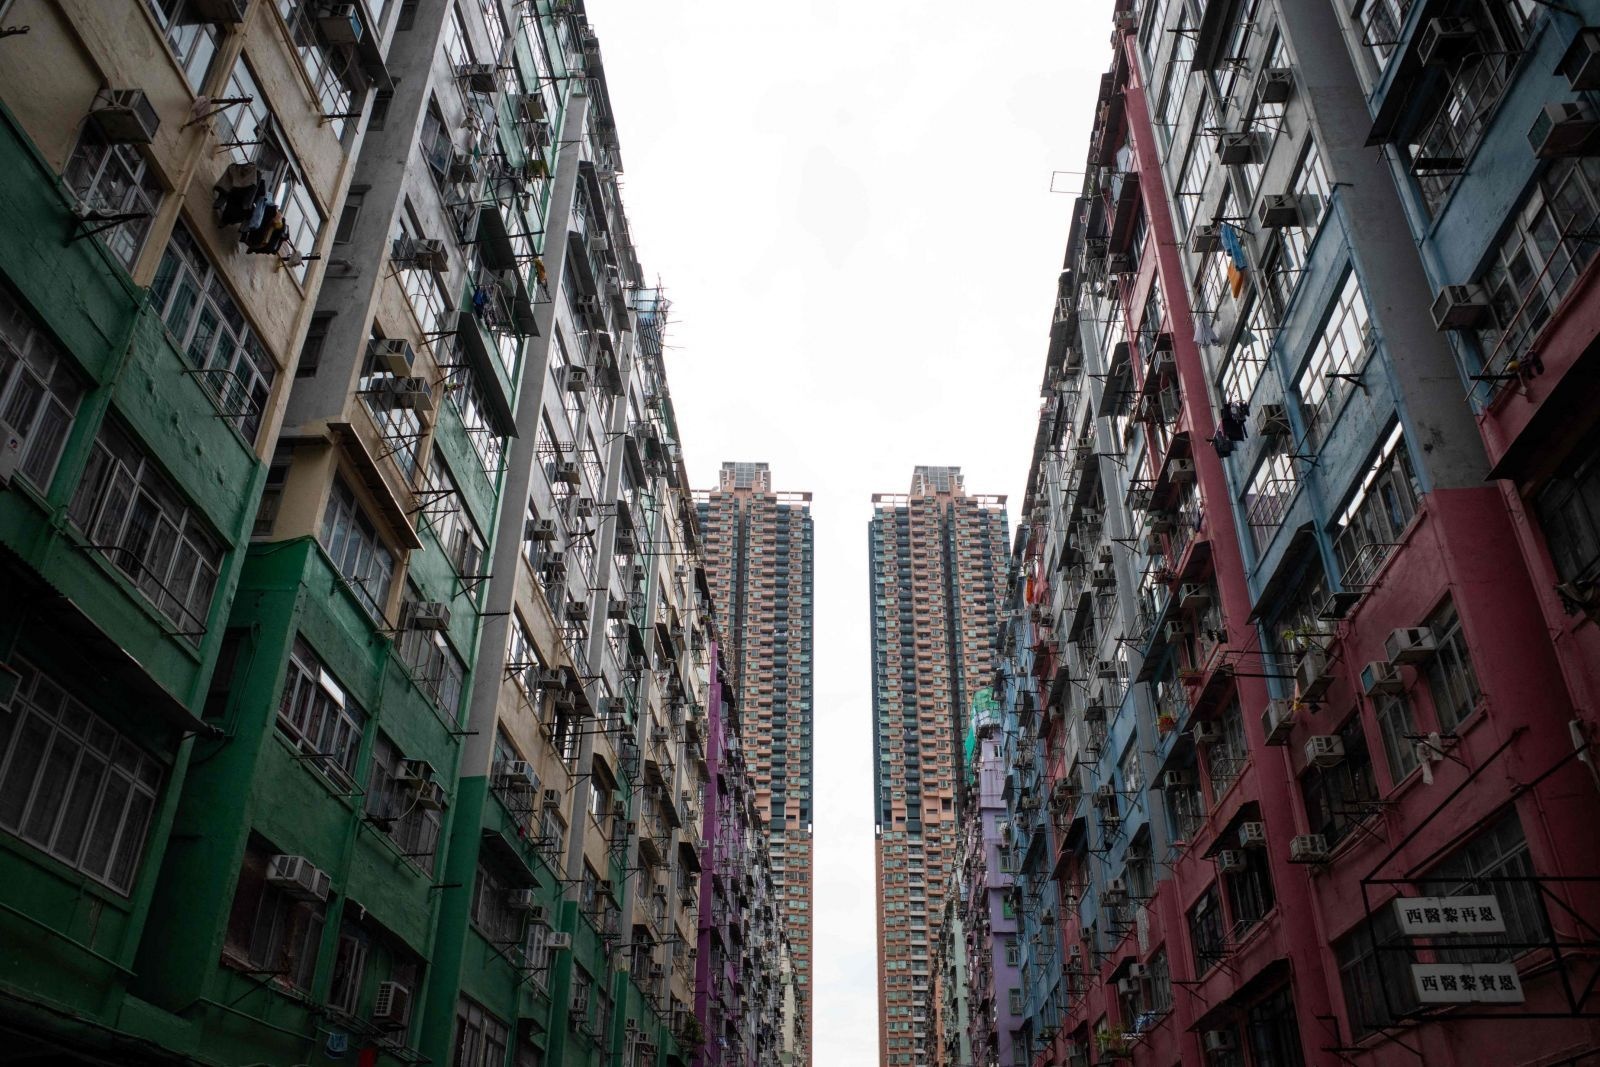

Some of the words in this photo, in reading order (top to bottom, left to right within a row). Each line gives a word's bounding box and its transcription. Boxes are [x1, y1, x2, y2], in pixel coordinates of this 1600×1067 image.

[1405, 906, 1496, 924] 西醫黎再恩
[1420, 974, 1517, 991] 西醫黎寶恩
